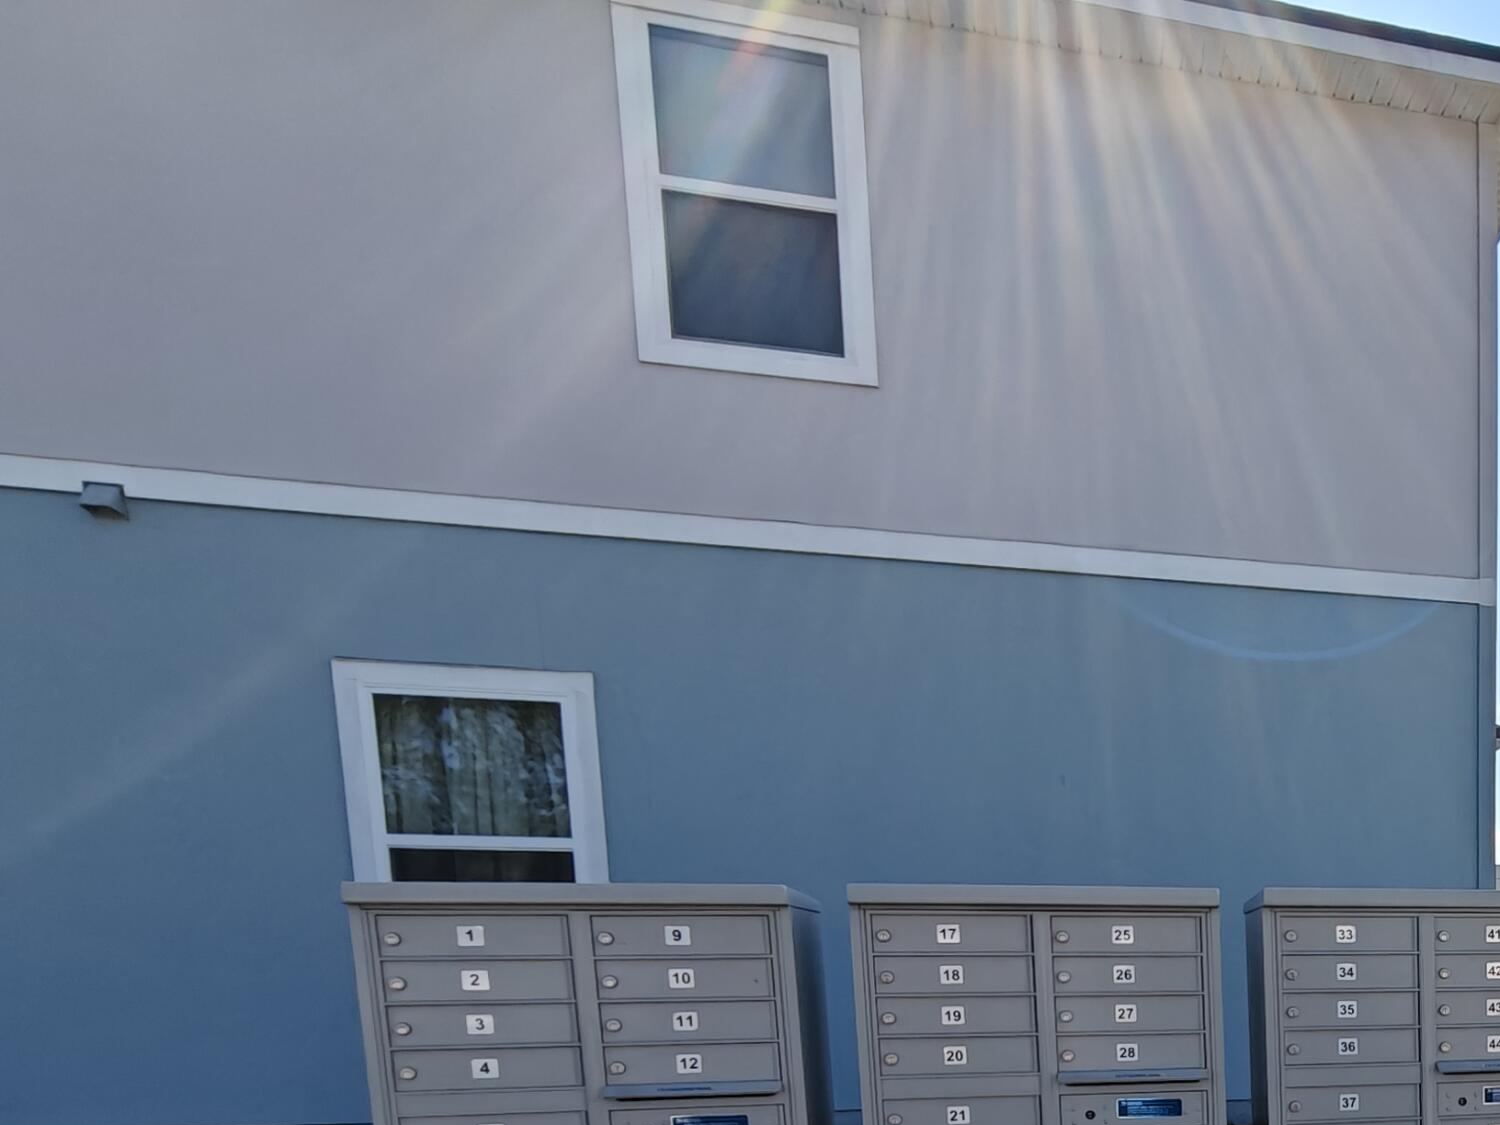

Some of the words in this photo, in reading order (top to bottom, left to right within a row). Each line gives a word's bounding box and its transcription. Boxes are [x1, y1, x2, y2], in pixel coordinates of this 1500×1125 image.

[465, 929, 474, 942] 1
[671, 929, 682, 942] 9
[939, 928, 957, 940] 17
[1114, 929, 1131, 941] 25
[1338, 928, 1354, 941] 33
[1487, 928, 1500, 940] 41
[943, 969, 960, 981] 18
[1116, 968, 1133, 981] 26
[1339, 966, 1354, 978] 34
[469, 973, 480, 986] 2
[672, 972, 691, 985] 10
[944, 1010, 962, 1022] 19
[1118, 1007, 1134, 1020] 27
[1340, 1004, 1355, 1016] 35
[475, 1018, 486, 1031] 3
[676, 1015, 693, 1027] 11
[1119, 1047, 1136, 1058] 28
[1340, 1041, 1356, 1053] 36
[946, 1049, 964, 1062] 20
[479, 1062, 490, 1074] 4
[680, 1057, 699, 1070] 12
[1342, 1096, 1357, 1109] 37
[949, 1110, 966, 1122] 21
